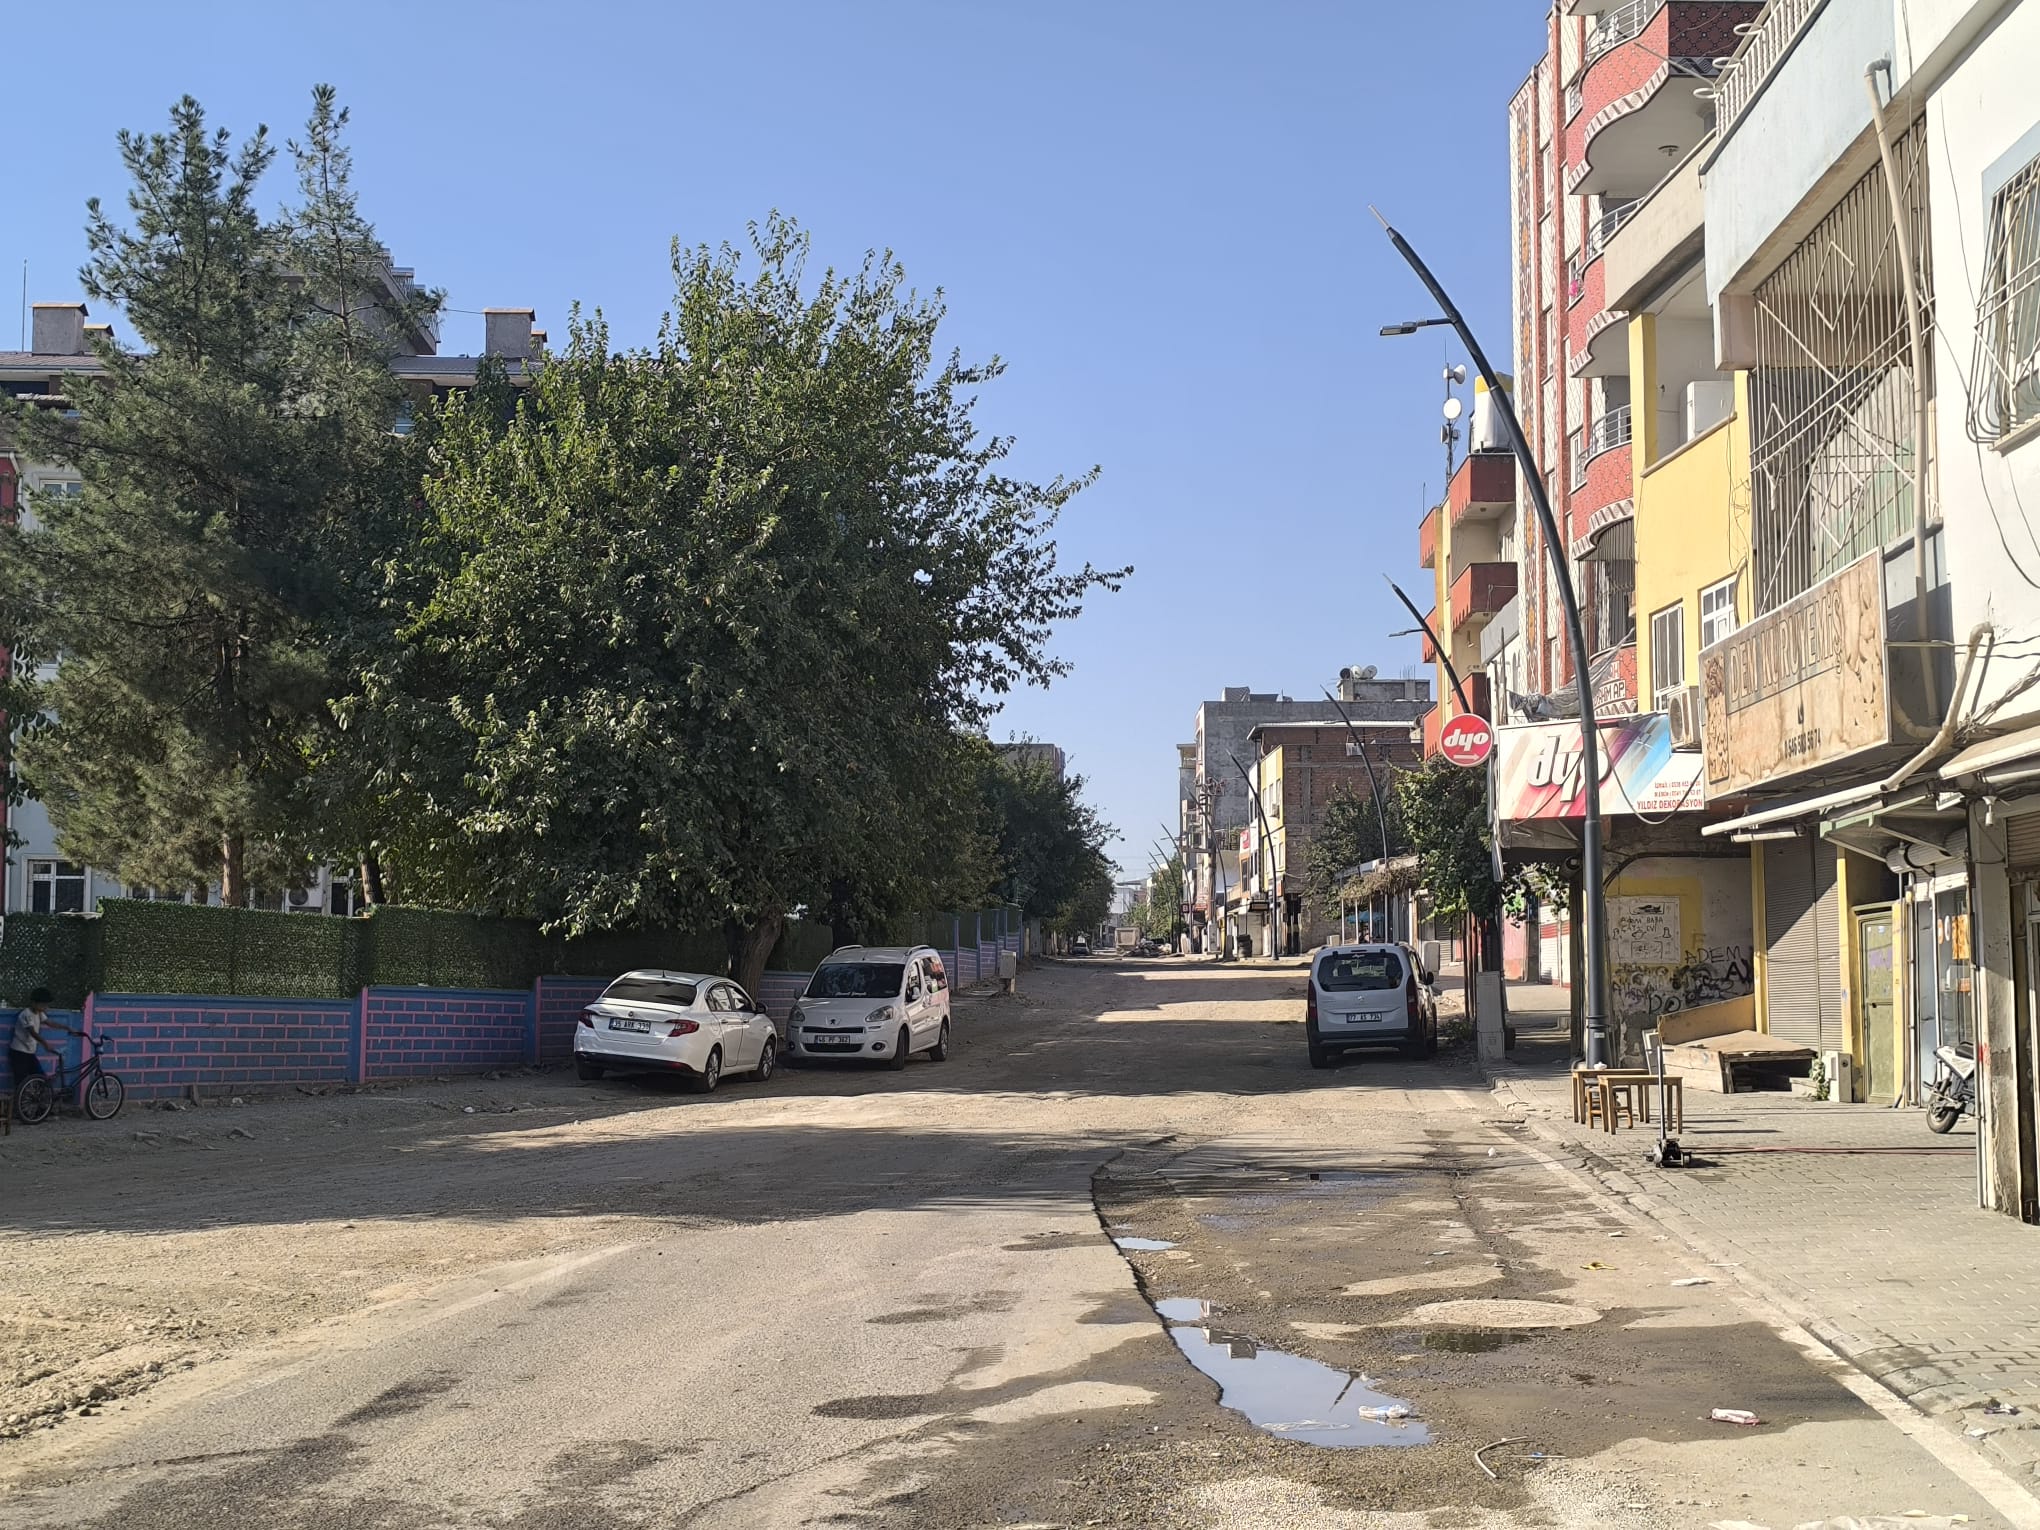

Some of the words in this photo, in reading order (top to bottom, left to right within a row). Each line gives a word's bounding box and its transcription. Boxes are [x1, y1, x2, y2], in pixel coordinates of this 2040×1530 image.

[1730, 635, 1759, 703] DEM
[1443, 728, 1489, 752] dyo
[1637, 799, 1658, 810] YILDIZ
[1684, 945, 1741, 965] ADEM
